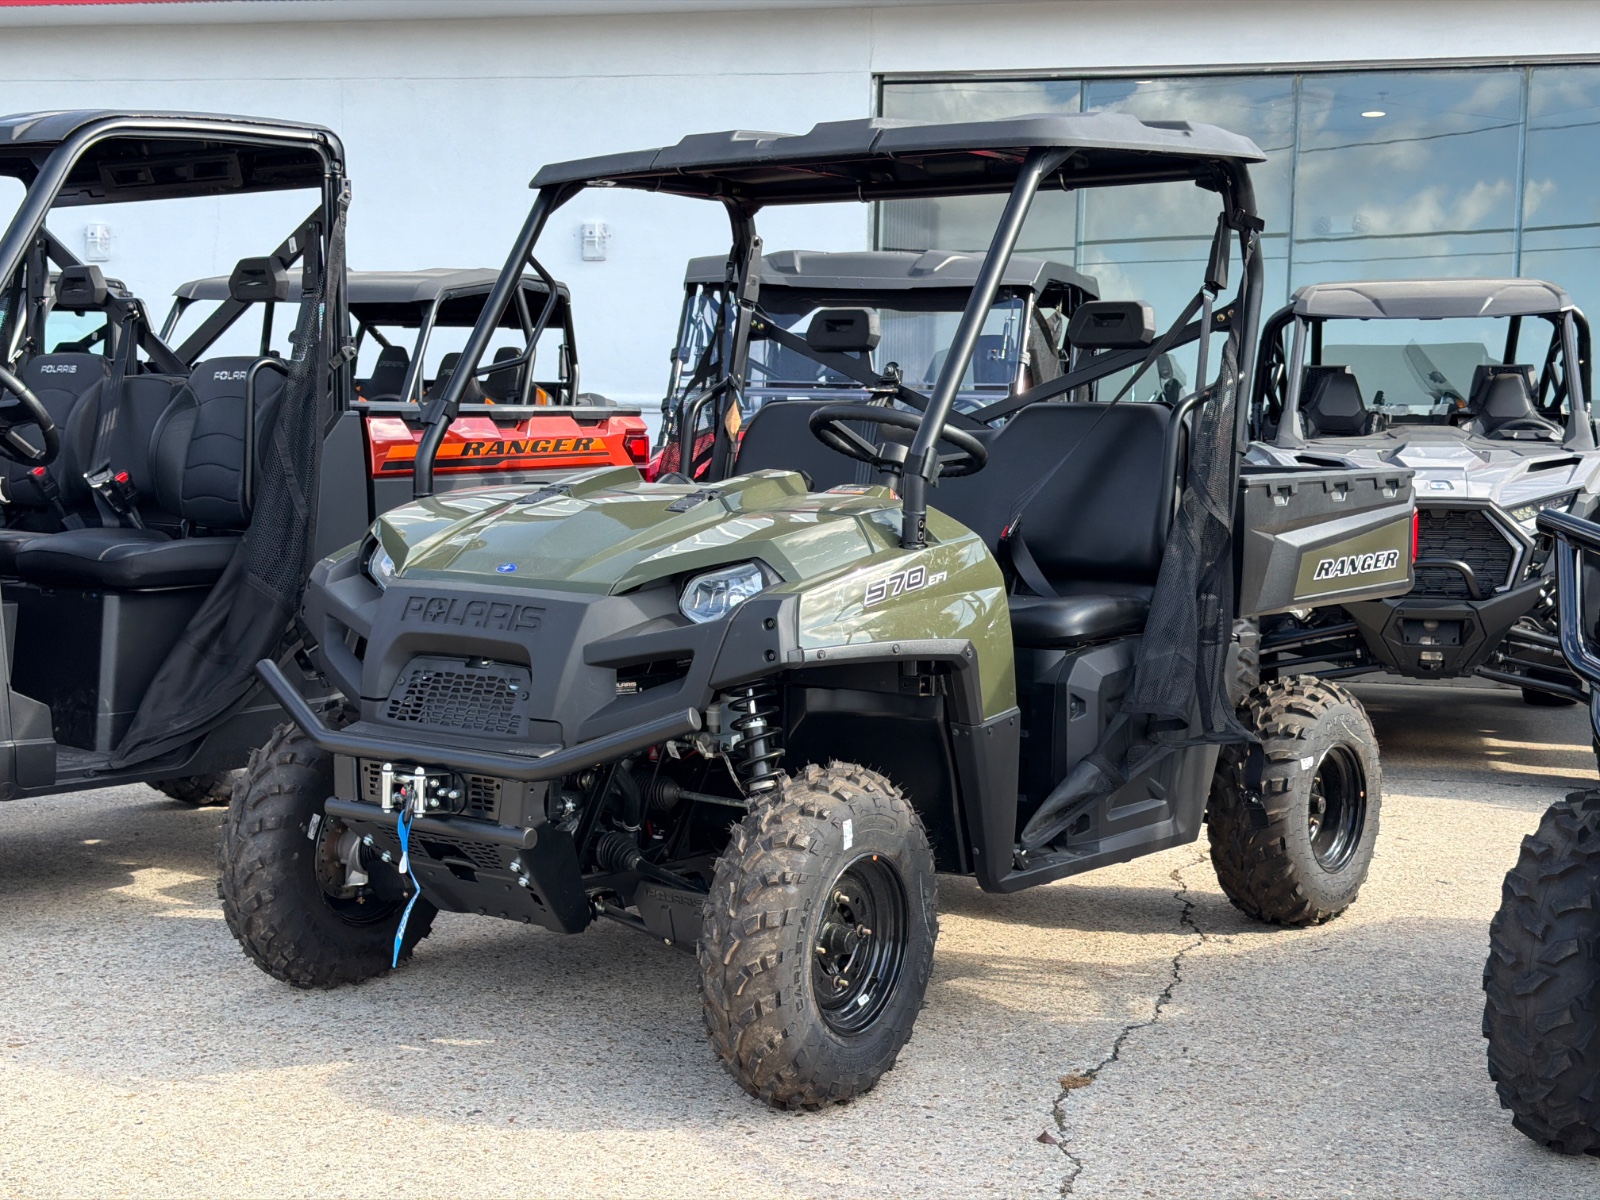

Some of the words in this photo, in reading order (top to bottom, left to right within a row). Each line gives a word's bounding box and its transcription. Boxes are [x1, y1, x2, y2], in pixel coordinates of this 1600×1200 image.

[40, 365, 77, 374] POLARIS
[213, 371, 247, 381] POLAR
[461, 437, 595, 457] RANGER
[1313, 550, 1399, 580] RANGER
[864, 565, 926, 608] 570
[928, 571, 948, 586] EFI
[401, 596, 546, 632] POLARIS
[794, 898, 812, 1013] CARLSTAR
